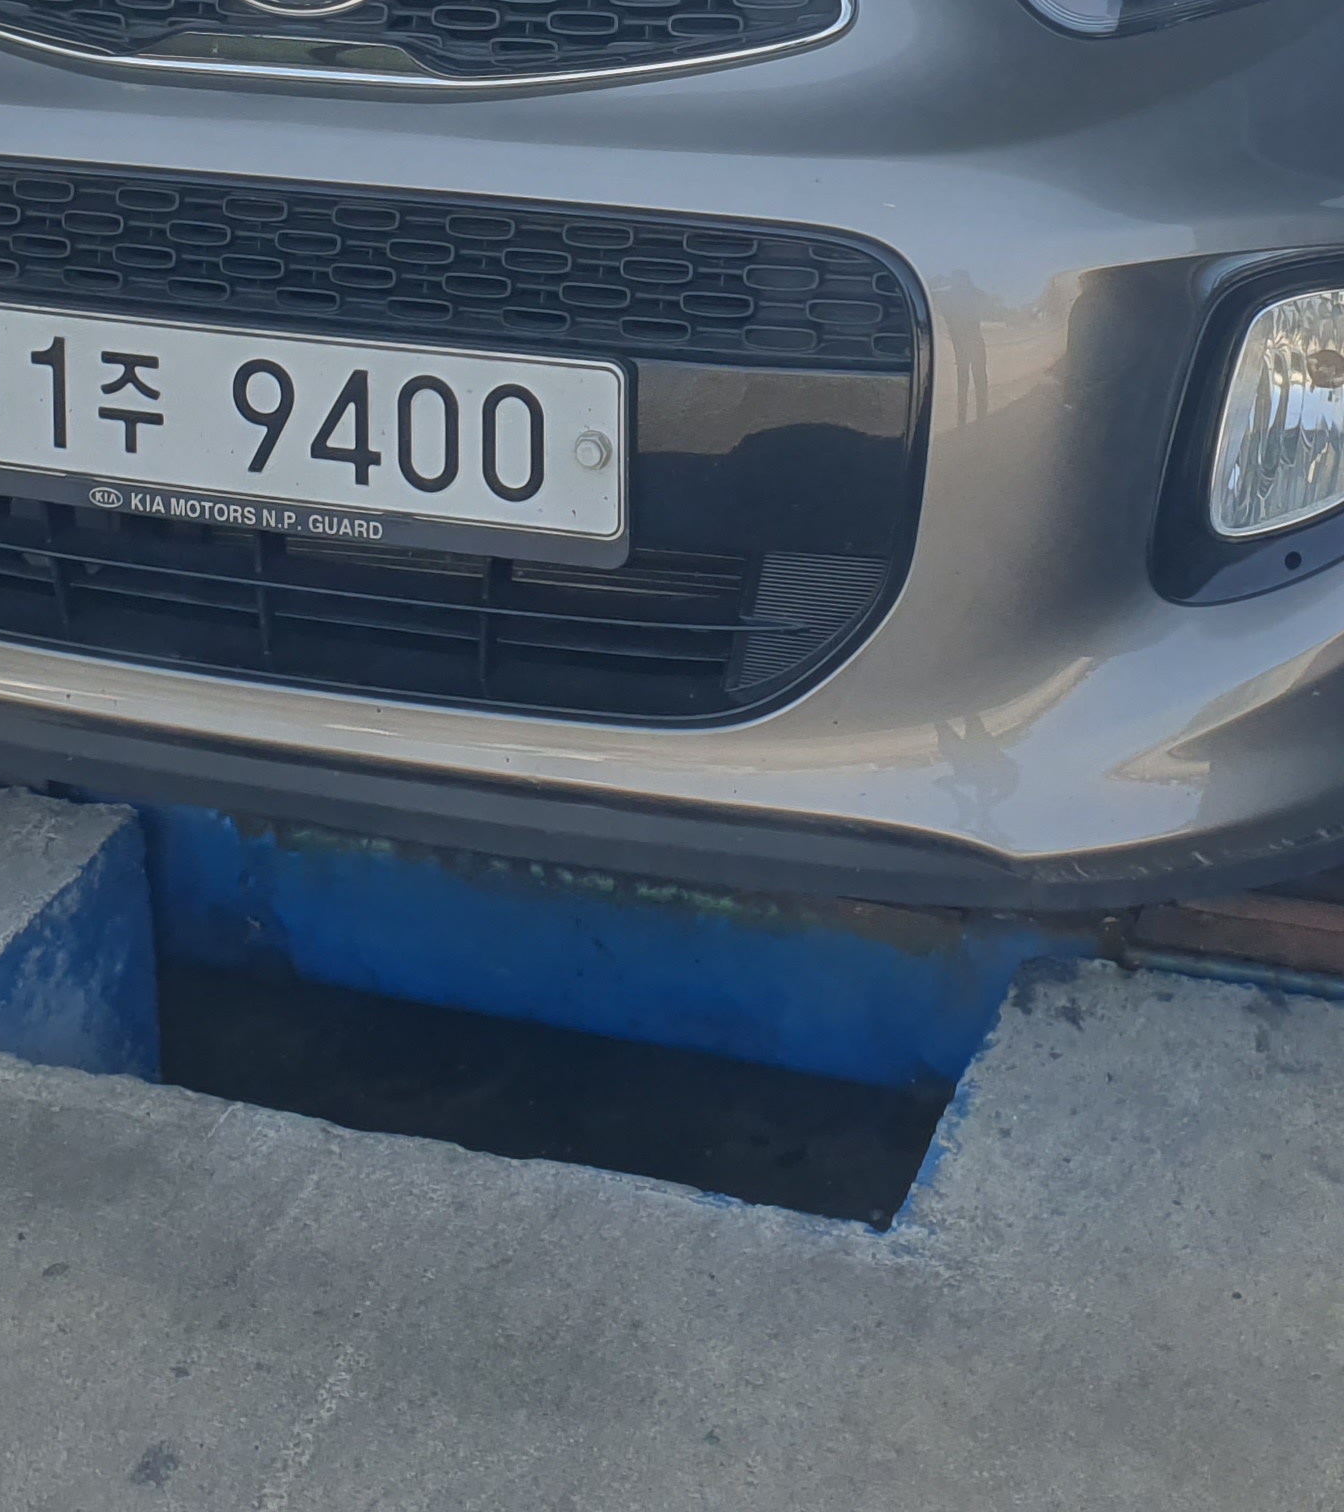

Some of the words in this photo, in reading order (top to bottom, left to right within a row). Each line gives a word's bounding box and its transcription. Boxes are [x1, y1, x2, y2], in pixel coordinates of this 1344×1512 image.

[232, 358, 545, 503] 9400
[130, 492, 165, 514] KIA
[170, 497, 257, 525] MOTORS
[262, 512, 302, 531] N.P.
[308, 514, 383, 539] GUARD
